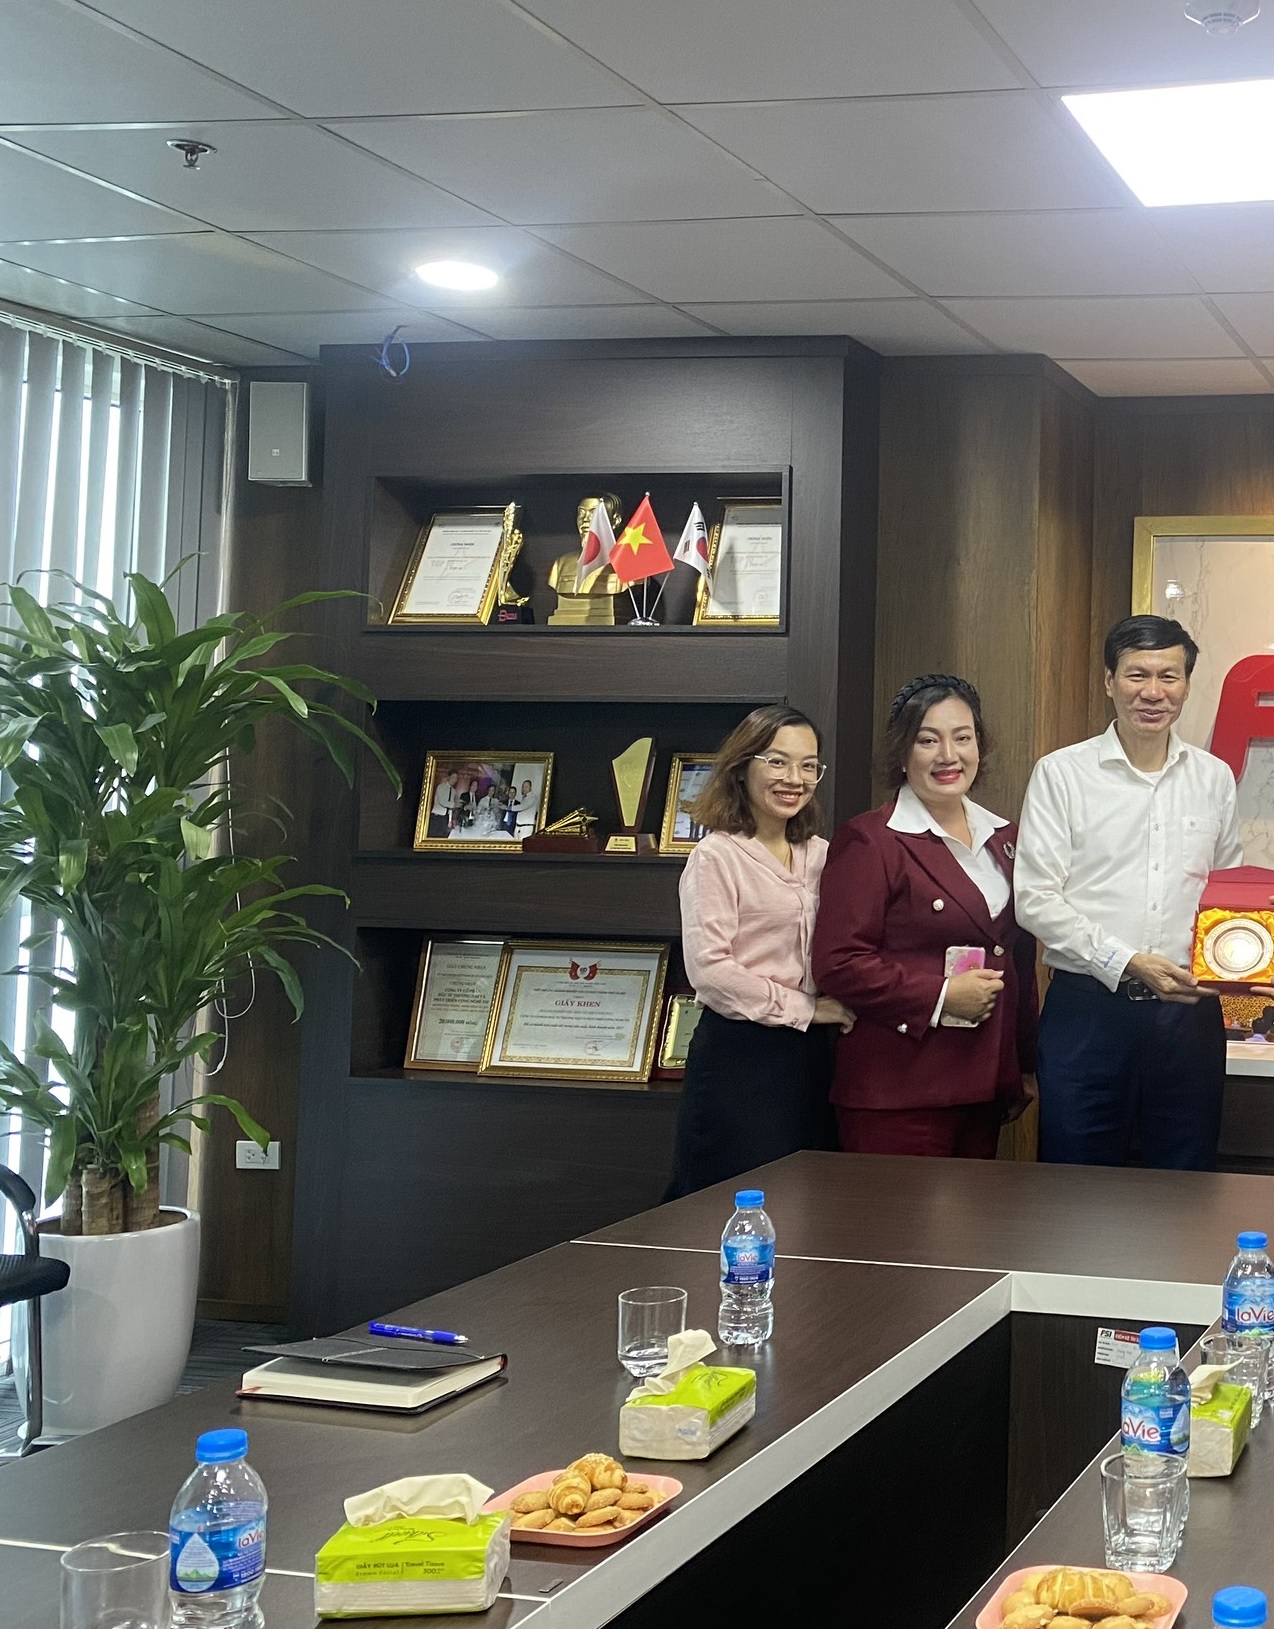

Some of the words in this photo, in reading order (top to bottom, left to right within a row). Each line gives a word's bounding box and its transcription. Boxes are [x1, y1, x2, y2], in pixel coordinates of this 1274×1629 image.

[554, 998, 576, 1007] GIẤY
[577, 1000, 601, 1008] KHEN
[737, 1254, 758, 1262] laVie
[1237, 1306, 1274, 1322] laVie
[1100, 1329, 1113, 1338] FSI
[1122, 1416, 1159, 1440] aVie
